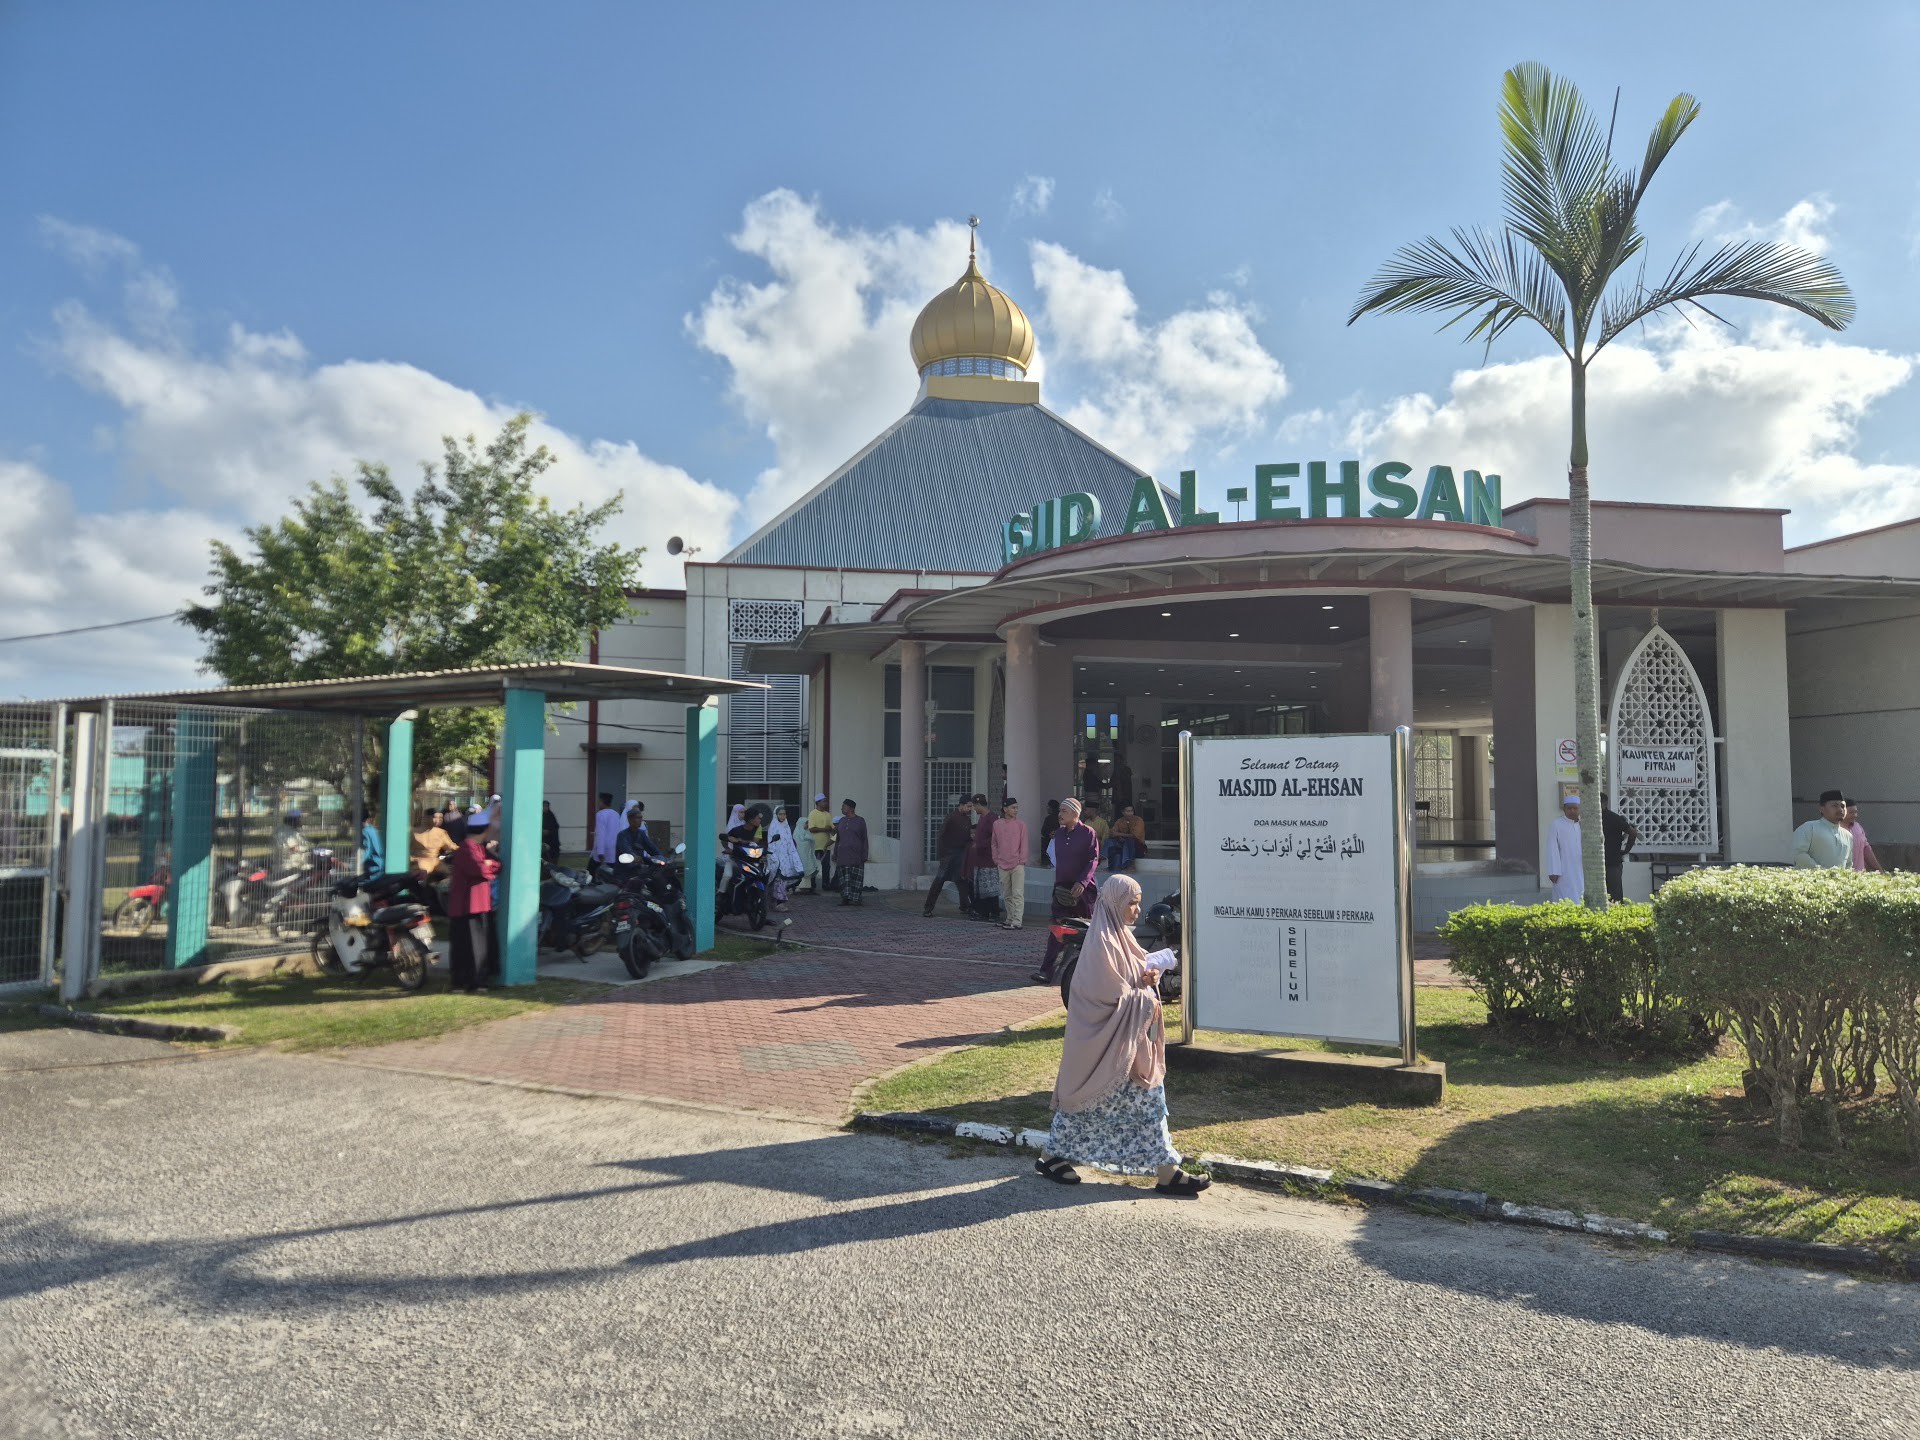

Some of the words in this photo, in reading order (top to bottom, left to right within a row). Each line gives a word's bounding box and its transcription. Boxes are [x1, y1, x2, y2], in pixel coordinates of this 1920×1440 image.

[1123, 460, 1502, 533] AL-EHSAN
[1622, 750, 1666, 760] KAUNTER
[1668, 751, 1694, 761] ZAKAT
[1240, 757, 1290, 770] Selamat
[1294, 756, 1340, 773] Datang
[1644, 761, 1676, 771] FITRAH
[1218, 778, 1277, 797] MASJID
[1281, 777, 1364, 797] AL-EHSAN
[1647, 776, 1693, 784] BERTAULIAH
[1253, 819, 1270, 827] DOA
[1270, 819, 1298, 827] MASUK
[1299, 819, 1329, 827] MASJID
[1213, 905, 1245, 917] INGATLAH
[1245, 906, 1264, 917] KAMU
[1266, 907, 1270, 917] 5
[1271, 907, 1302, 919] PERKARA
[1303, 909, 1335, 920] SEBELUM
[1336, 910, 1341, 920] 5
[1341, 910, 1374, 922] PERKARA
[1288, 926, 1299, 1002] SEBELUM
